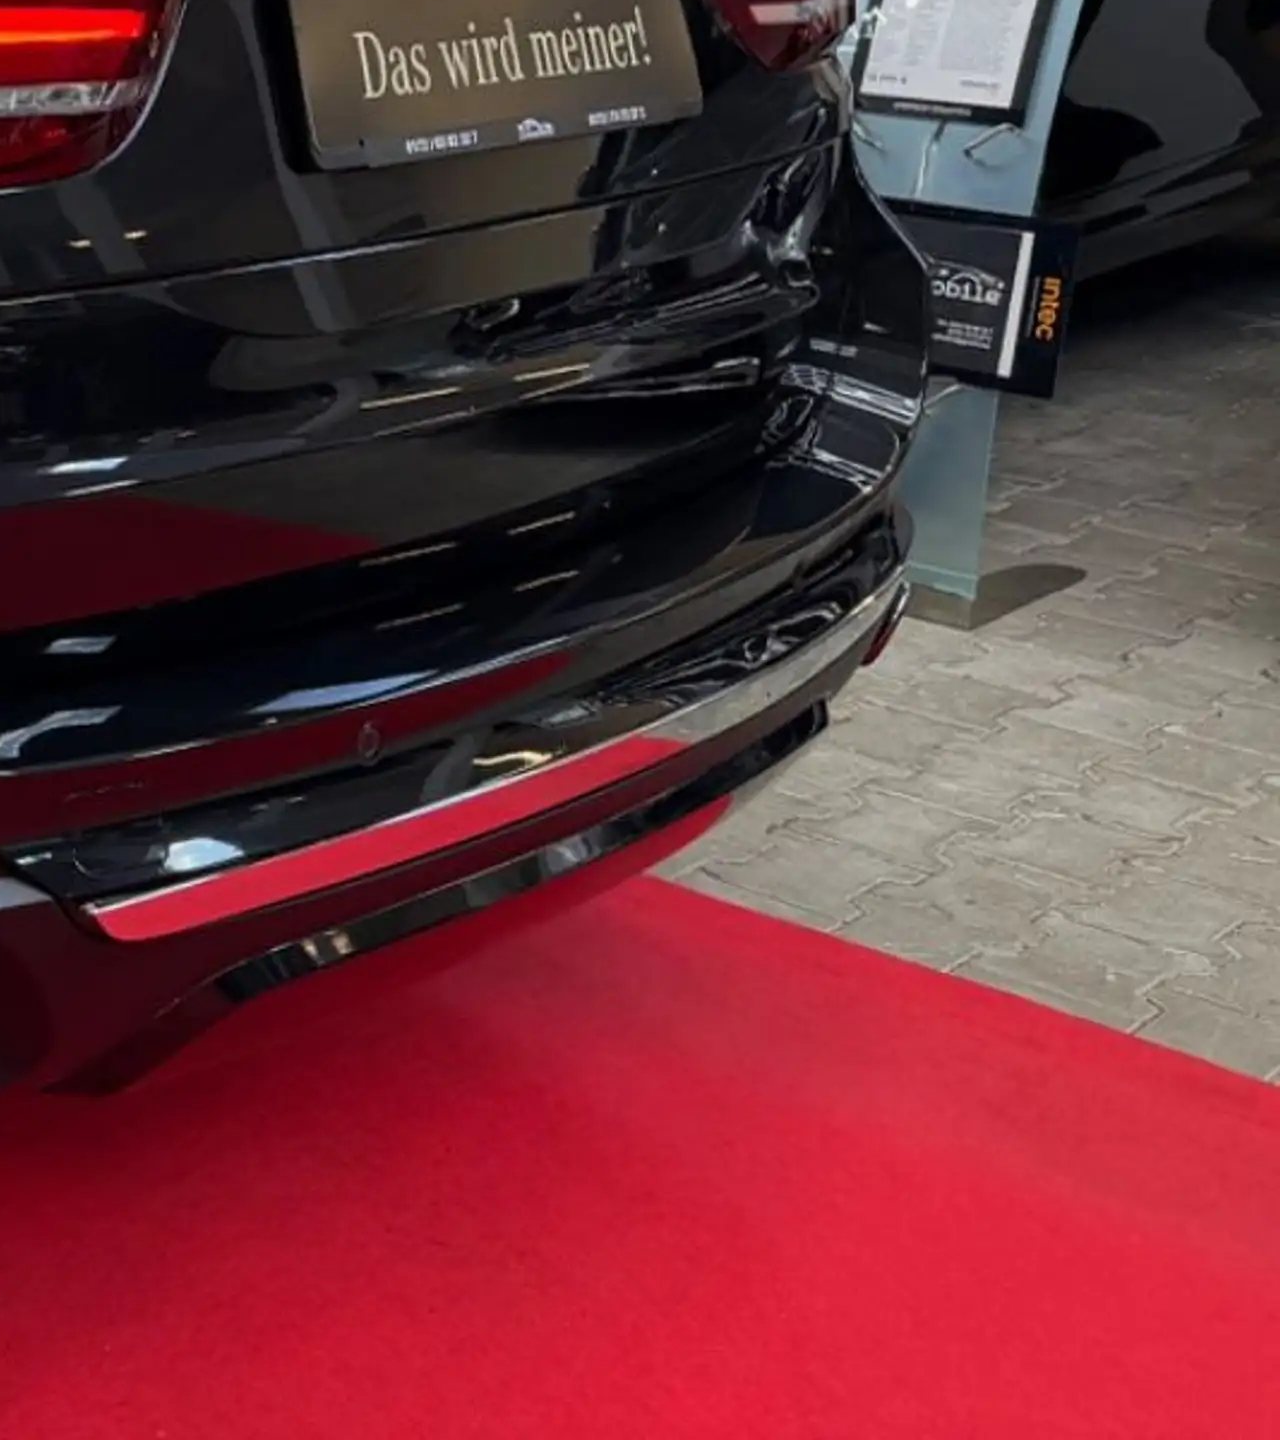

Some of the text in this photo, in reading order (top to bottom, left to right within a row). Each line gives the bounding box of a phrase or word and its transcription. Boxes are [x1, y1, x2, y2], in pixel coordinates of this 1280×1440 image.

[352, 4, 652, 100] Das wird meiner!
[1034, 276, 1062, 342] intec
